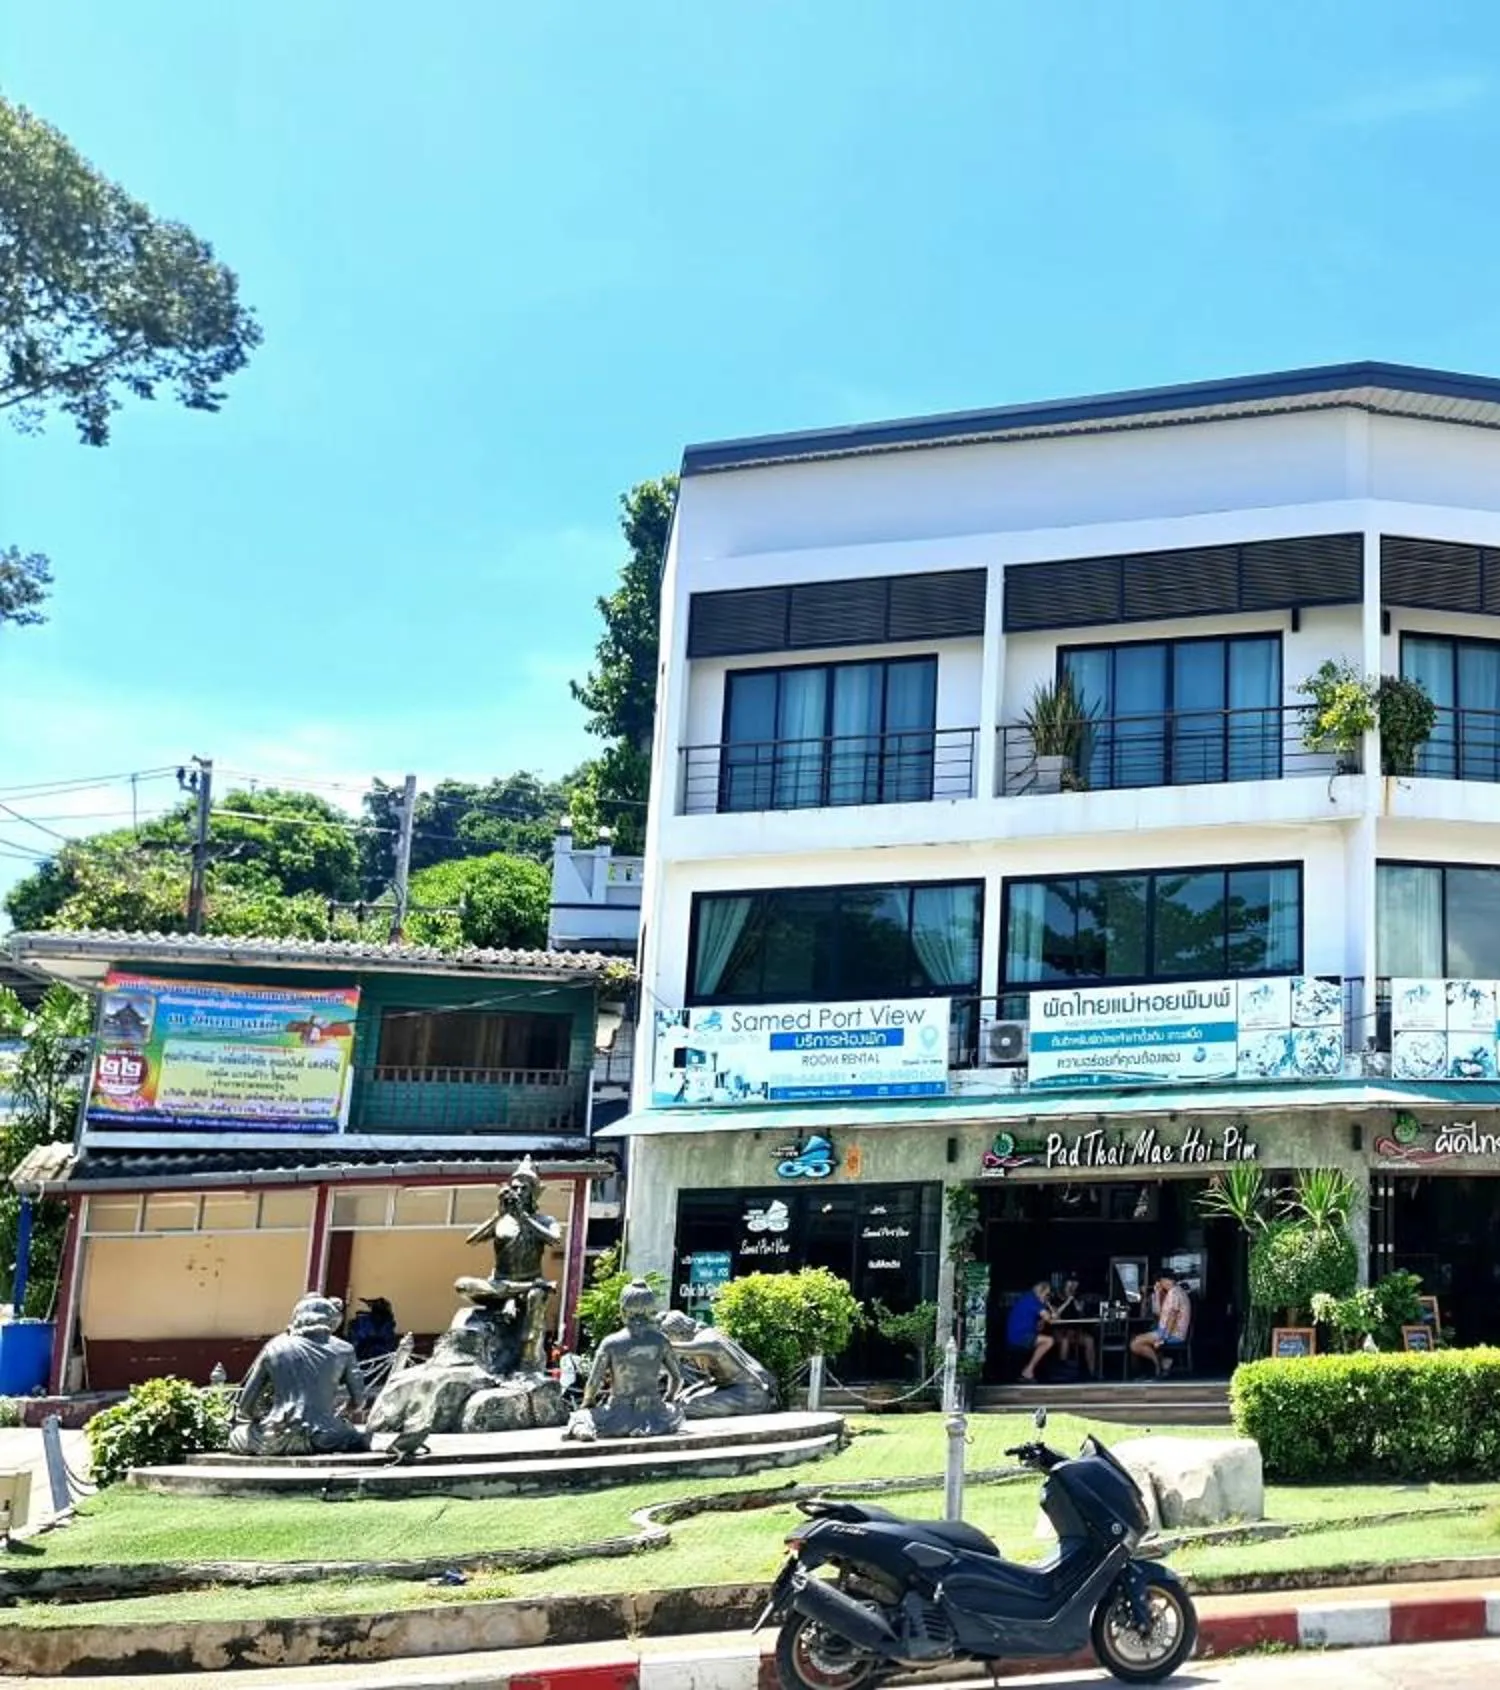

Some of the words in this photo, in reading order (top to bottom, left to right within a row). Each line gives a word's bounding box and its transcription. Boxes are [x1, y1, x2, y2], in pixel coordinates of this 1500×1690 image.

[731, 1009, 811, 1032] Samed
[819, 1006, 863, 1029] Port
[870, 1005, 926, 1027] View
[802, 1054, 839, 1066] ROOM
[841, 1052, 880, 1065] RENTAL
[1046, 1132, 1080, 1168] Pad
[1084, 1129, 1126, 1167] Thai
[1130, 1128, 1174, 1164] Mae
[1179, 1127, 1213, 1164] Hoi
[1222, 1125, 1258, 1162] Pim
